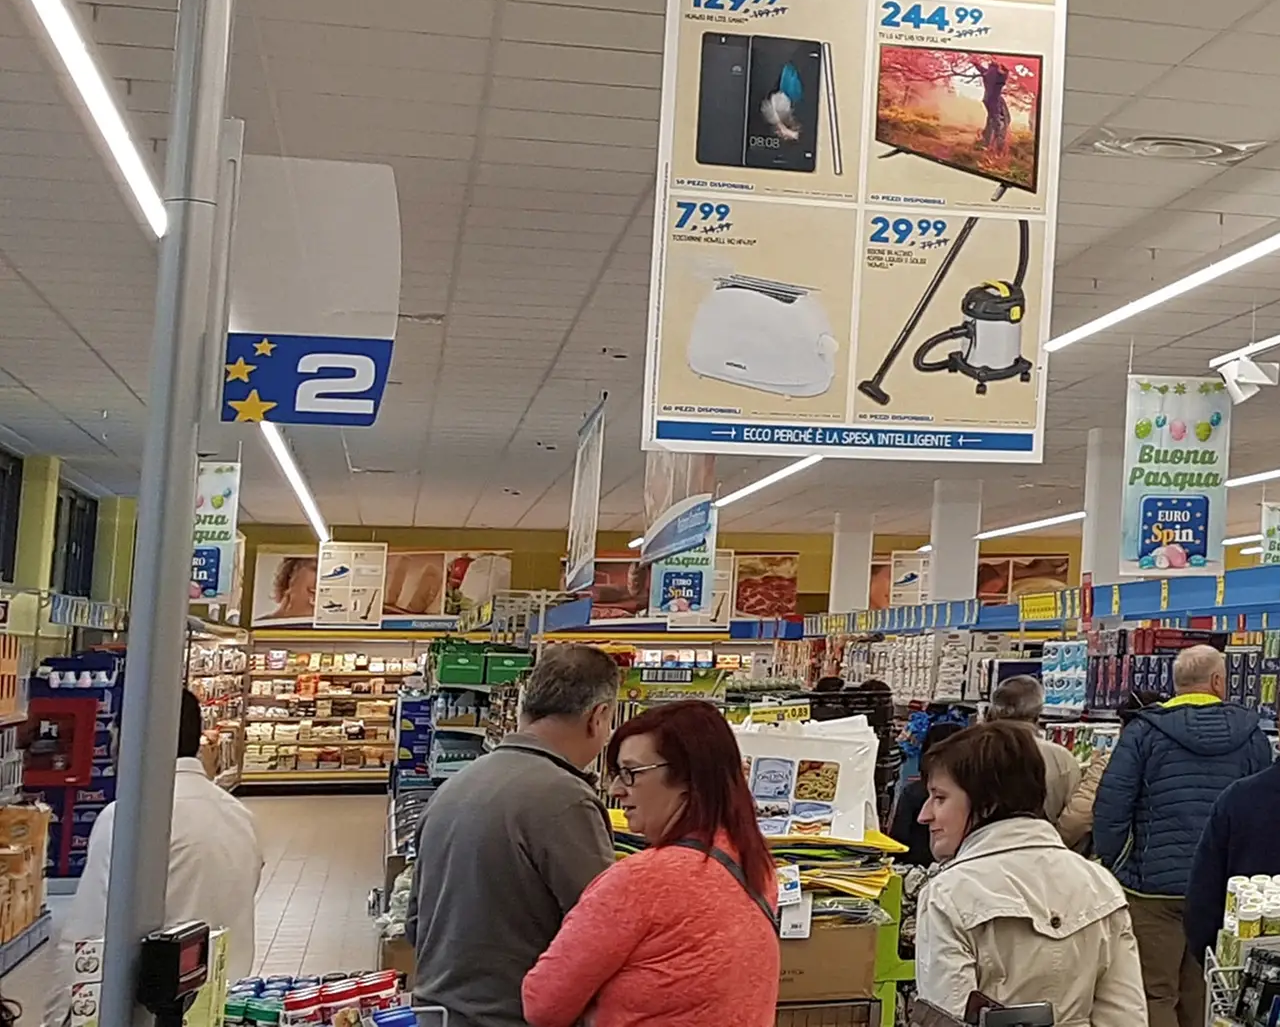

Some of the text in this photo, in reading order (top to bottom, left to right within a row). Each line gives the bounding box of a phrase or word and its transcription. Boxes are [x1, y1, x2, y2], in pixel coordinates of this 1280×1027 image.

[294, 353, 376, 414] 2
[744, 427, 952, 447] ECCO PERCHÉ È LA SPESA INTELLIGENTE
[1138, 444, 1218, 464] Buona
[1129, 467, 1222, 491] Pasqua
[1158, 510, 1190, 521] EURO
[1151, 523, 1194, 545] Spin
[664, 557, 709, 568] asqua
[668, 587, 694, 599] Spin
